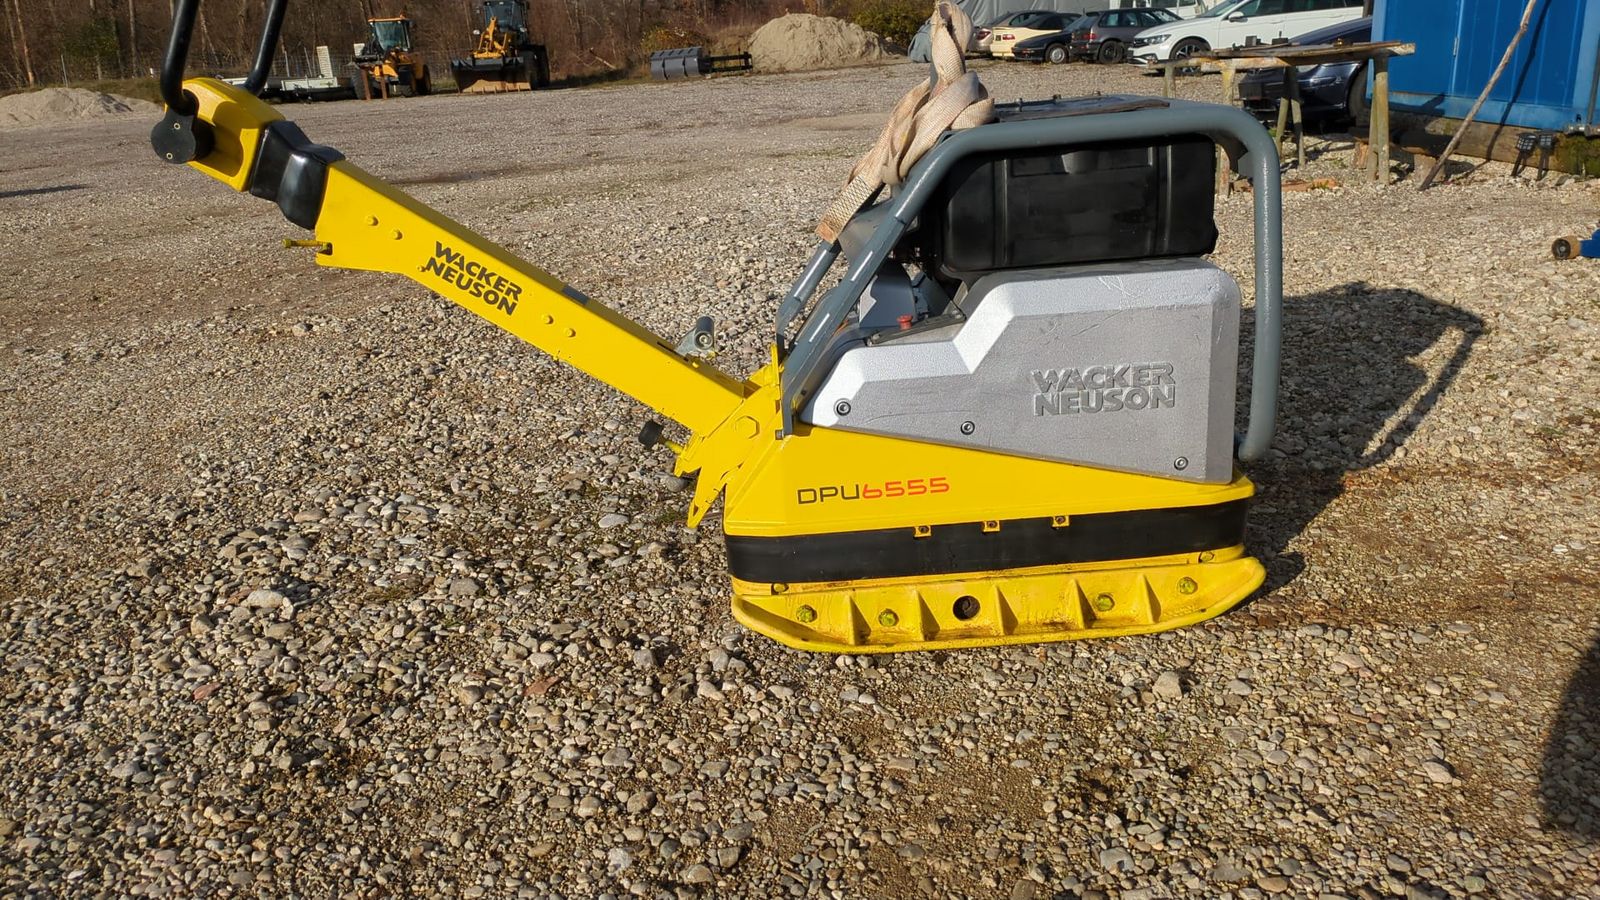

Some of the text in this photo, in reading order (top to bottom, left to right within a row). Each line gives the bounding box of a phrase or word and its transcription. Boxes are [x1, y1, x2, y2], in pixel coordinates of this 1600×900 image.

[426, 257, 517, 316] NEUSON
[435, 241, 522, 302] WACKER
[1031, 361, 1176, 394] WACKER
[1033, 385, 1176, 417] NEUSON
[797, 477, 950, 505] DPU6555
